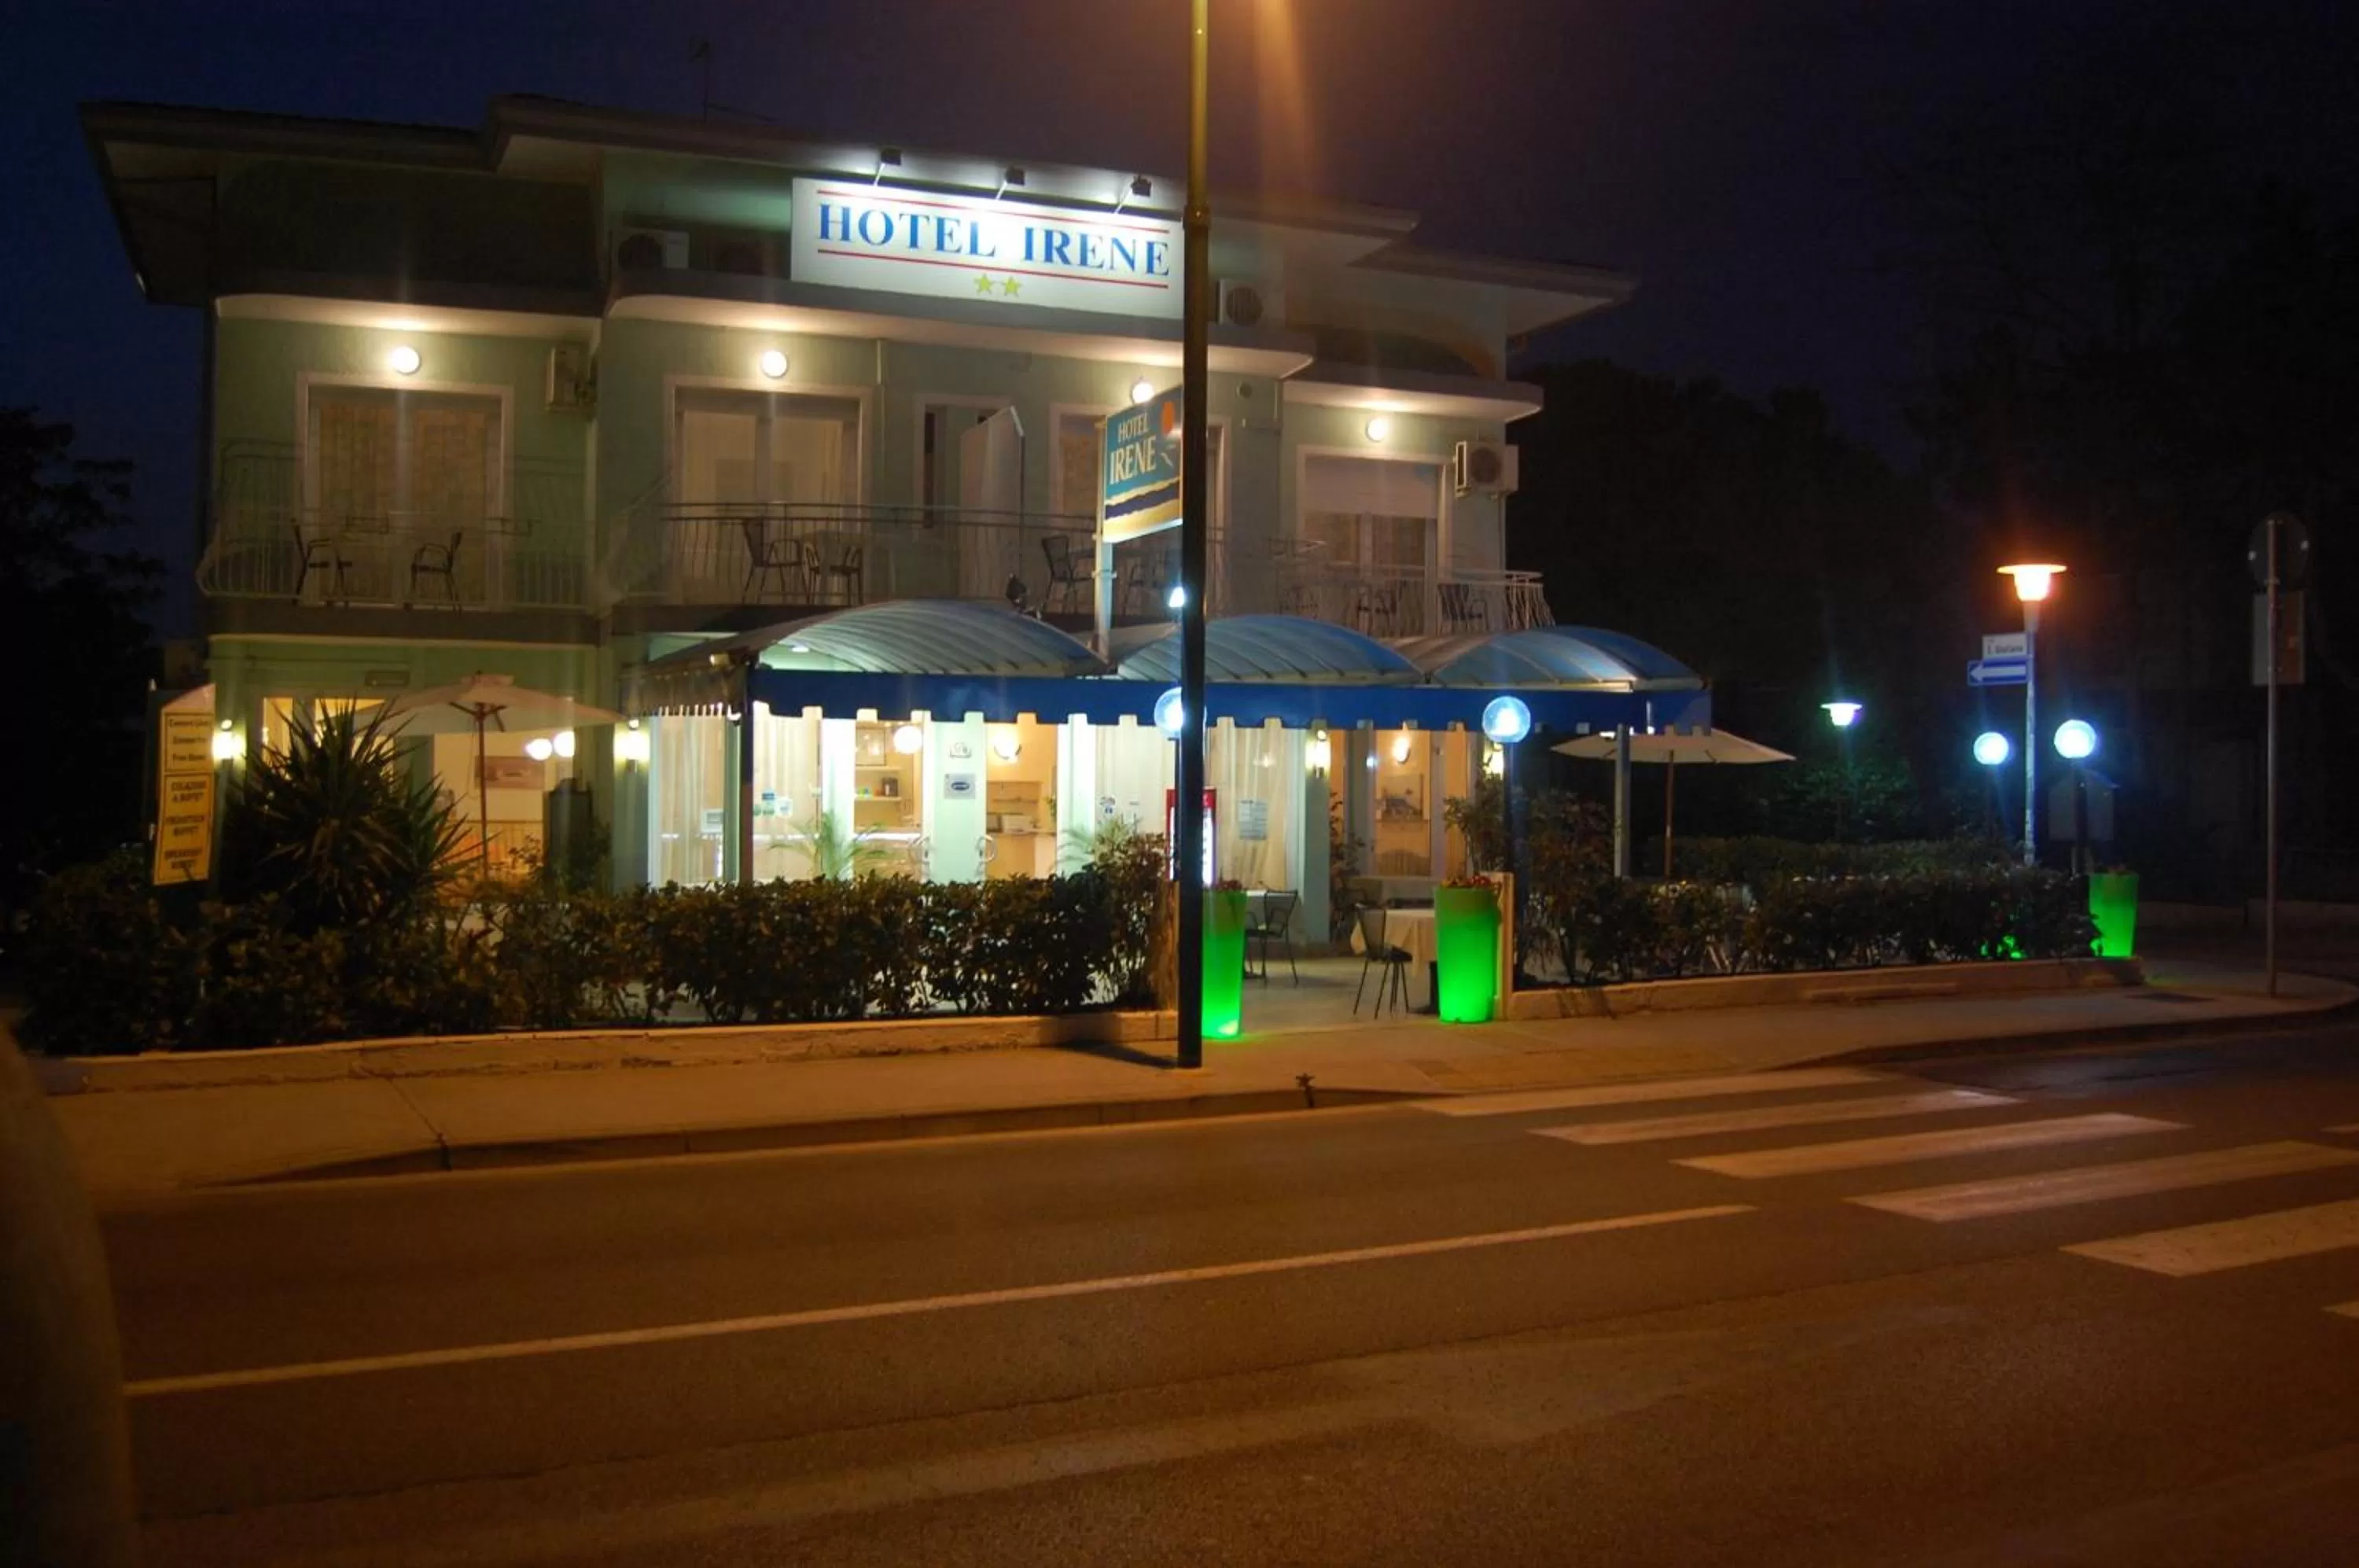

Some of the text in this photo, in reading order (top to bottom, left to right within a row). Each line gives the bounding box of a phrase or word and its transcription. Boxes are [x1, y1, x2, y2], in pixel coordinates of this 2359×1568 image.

[819, 203, 1169, 276] HOTEL IRENE
[1117, 413, 1149, 444] HOTEL
[1110, 435, 1157, 485] IRENE
